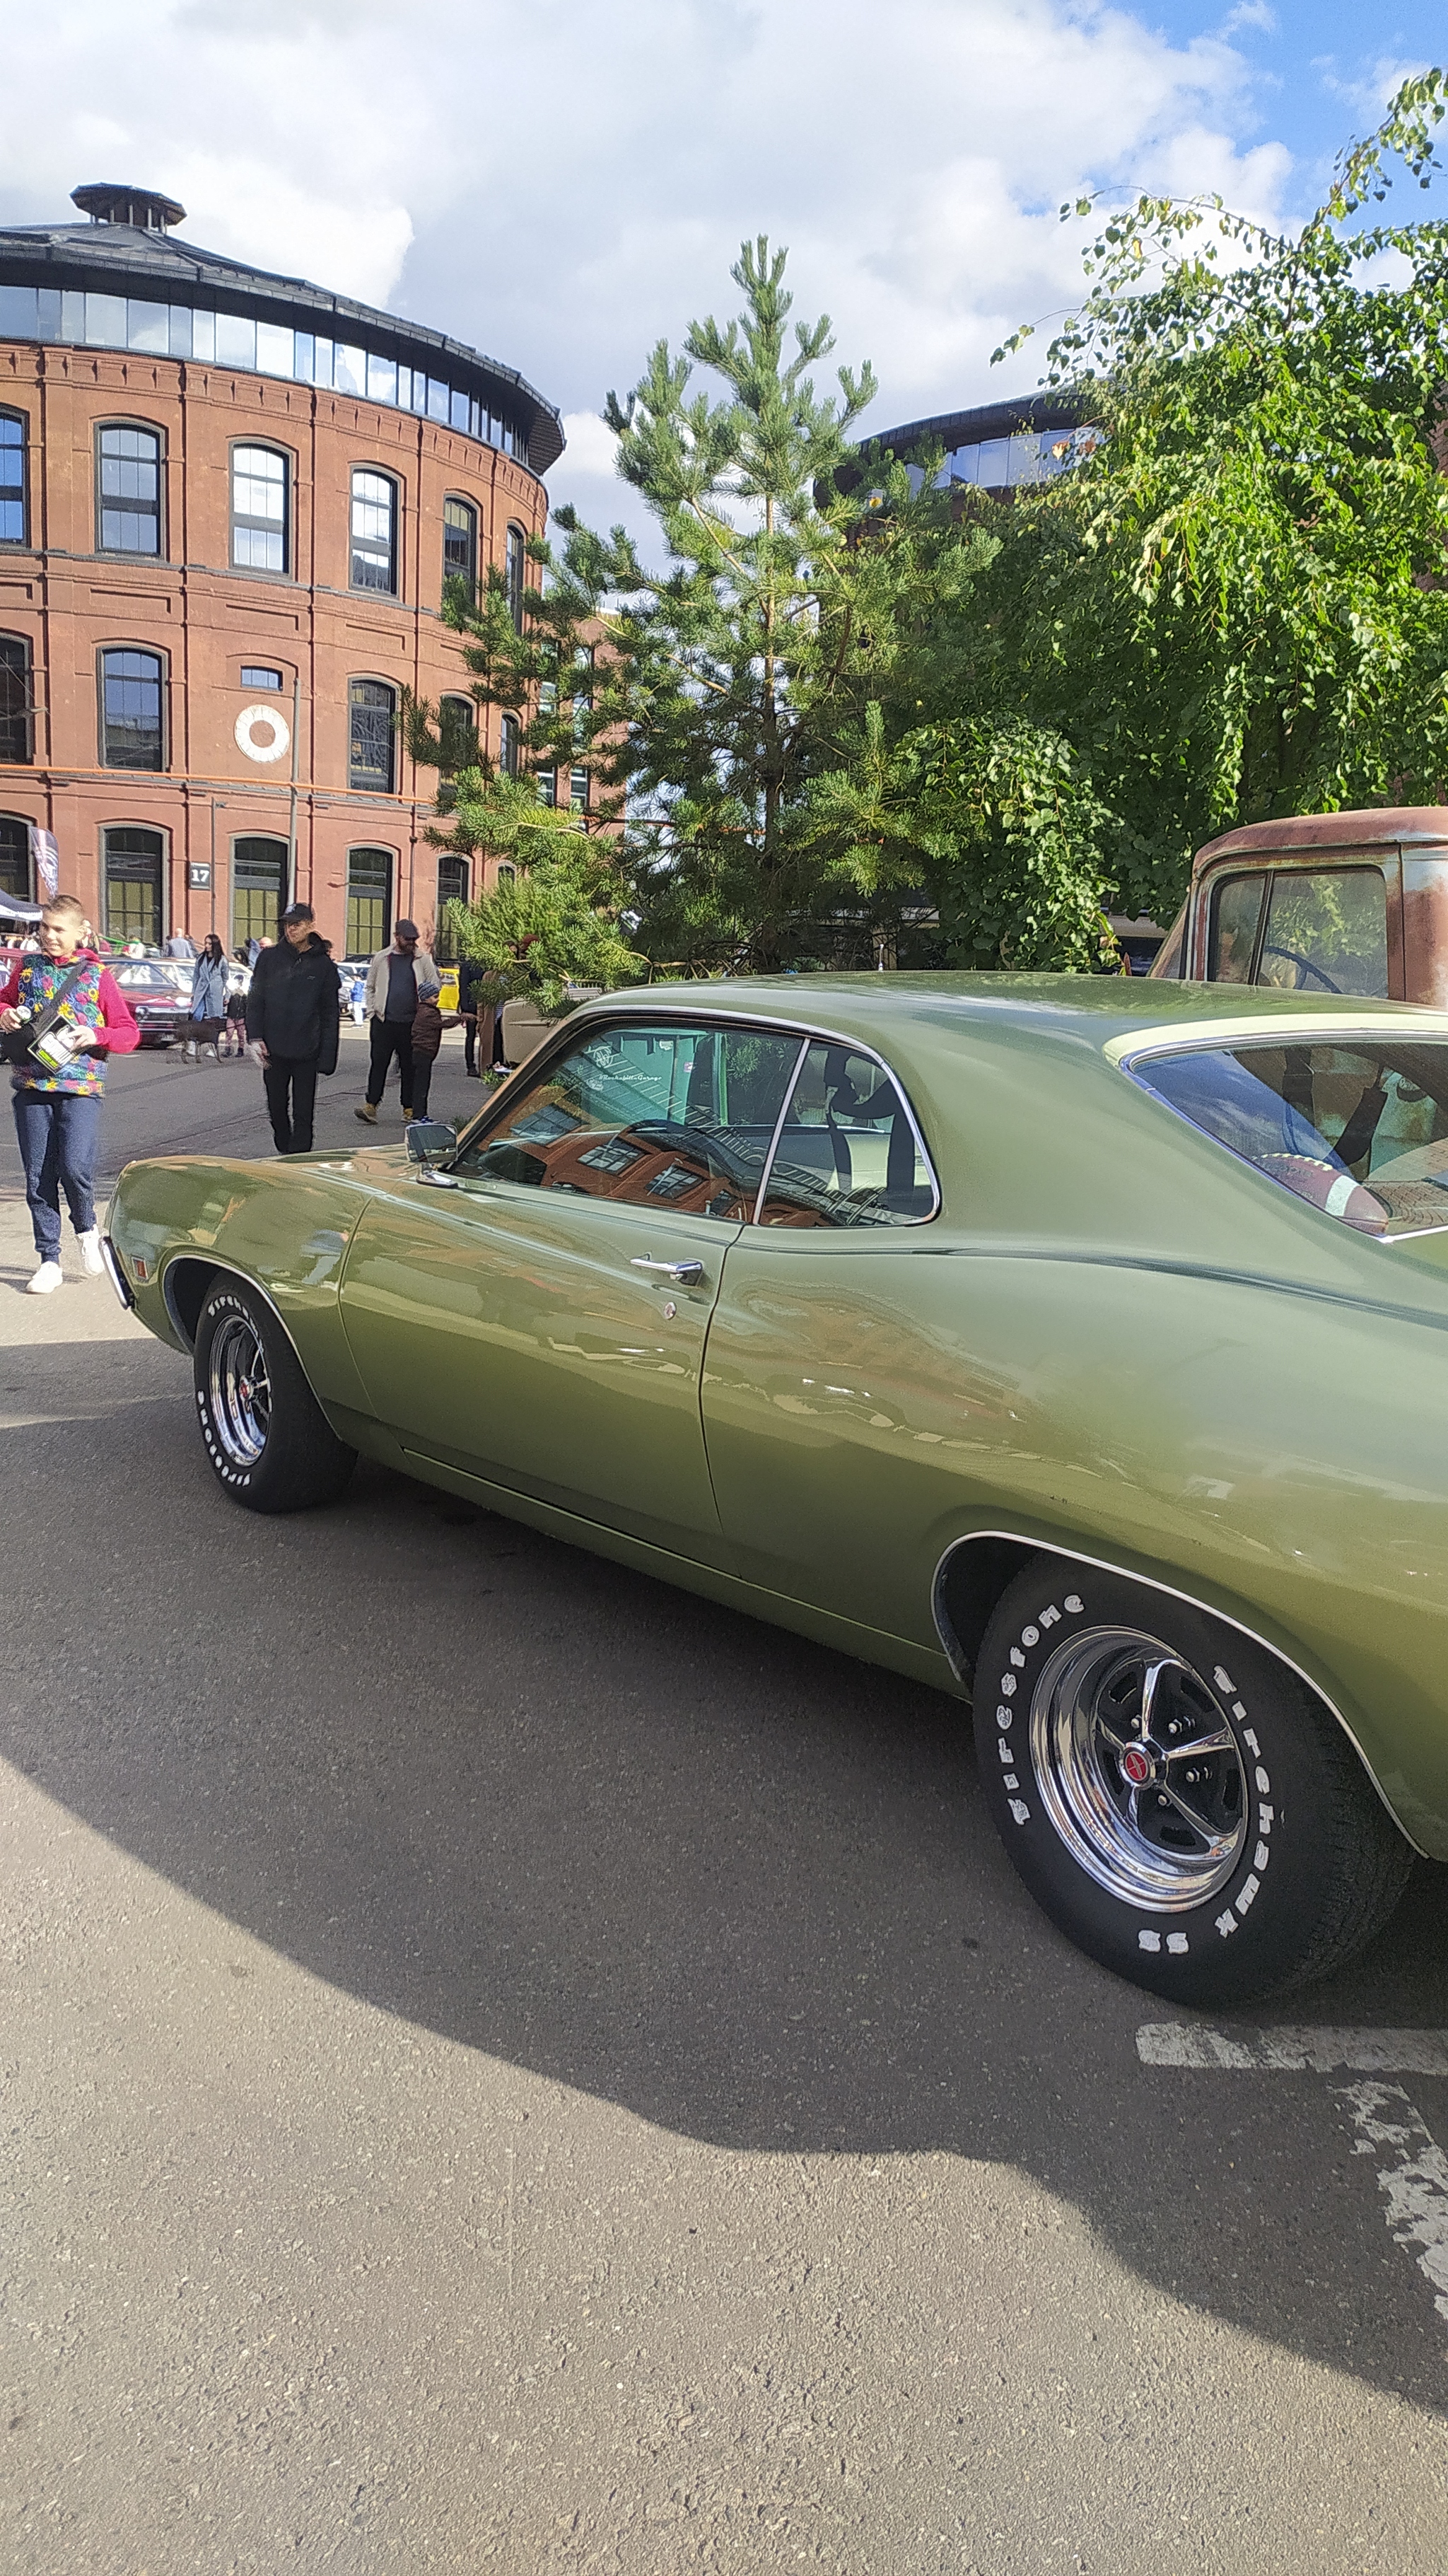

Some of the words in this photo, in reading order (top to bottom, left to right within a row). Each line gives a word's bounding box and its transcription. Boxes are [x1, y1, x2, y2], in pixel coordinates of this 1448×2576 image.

[191, 869, 210, 882] 17
[996, 1594, 1085, 1825] Firestone
[1213, 1665, 1274, 1938] Firehawk
[1138, 1929, 1189, 1954] SS
